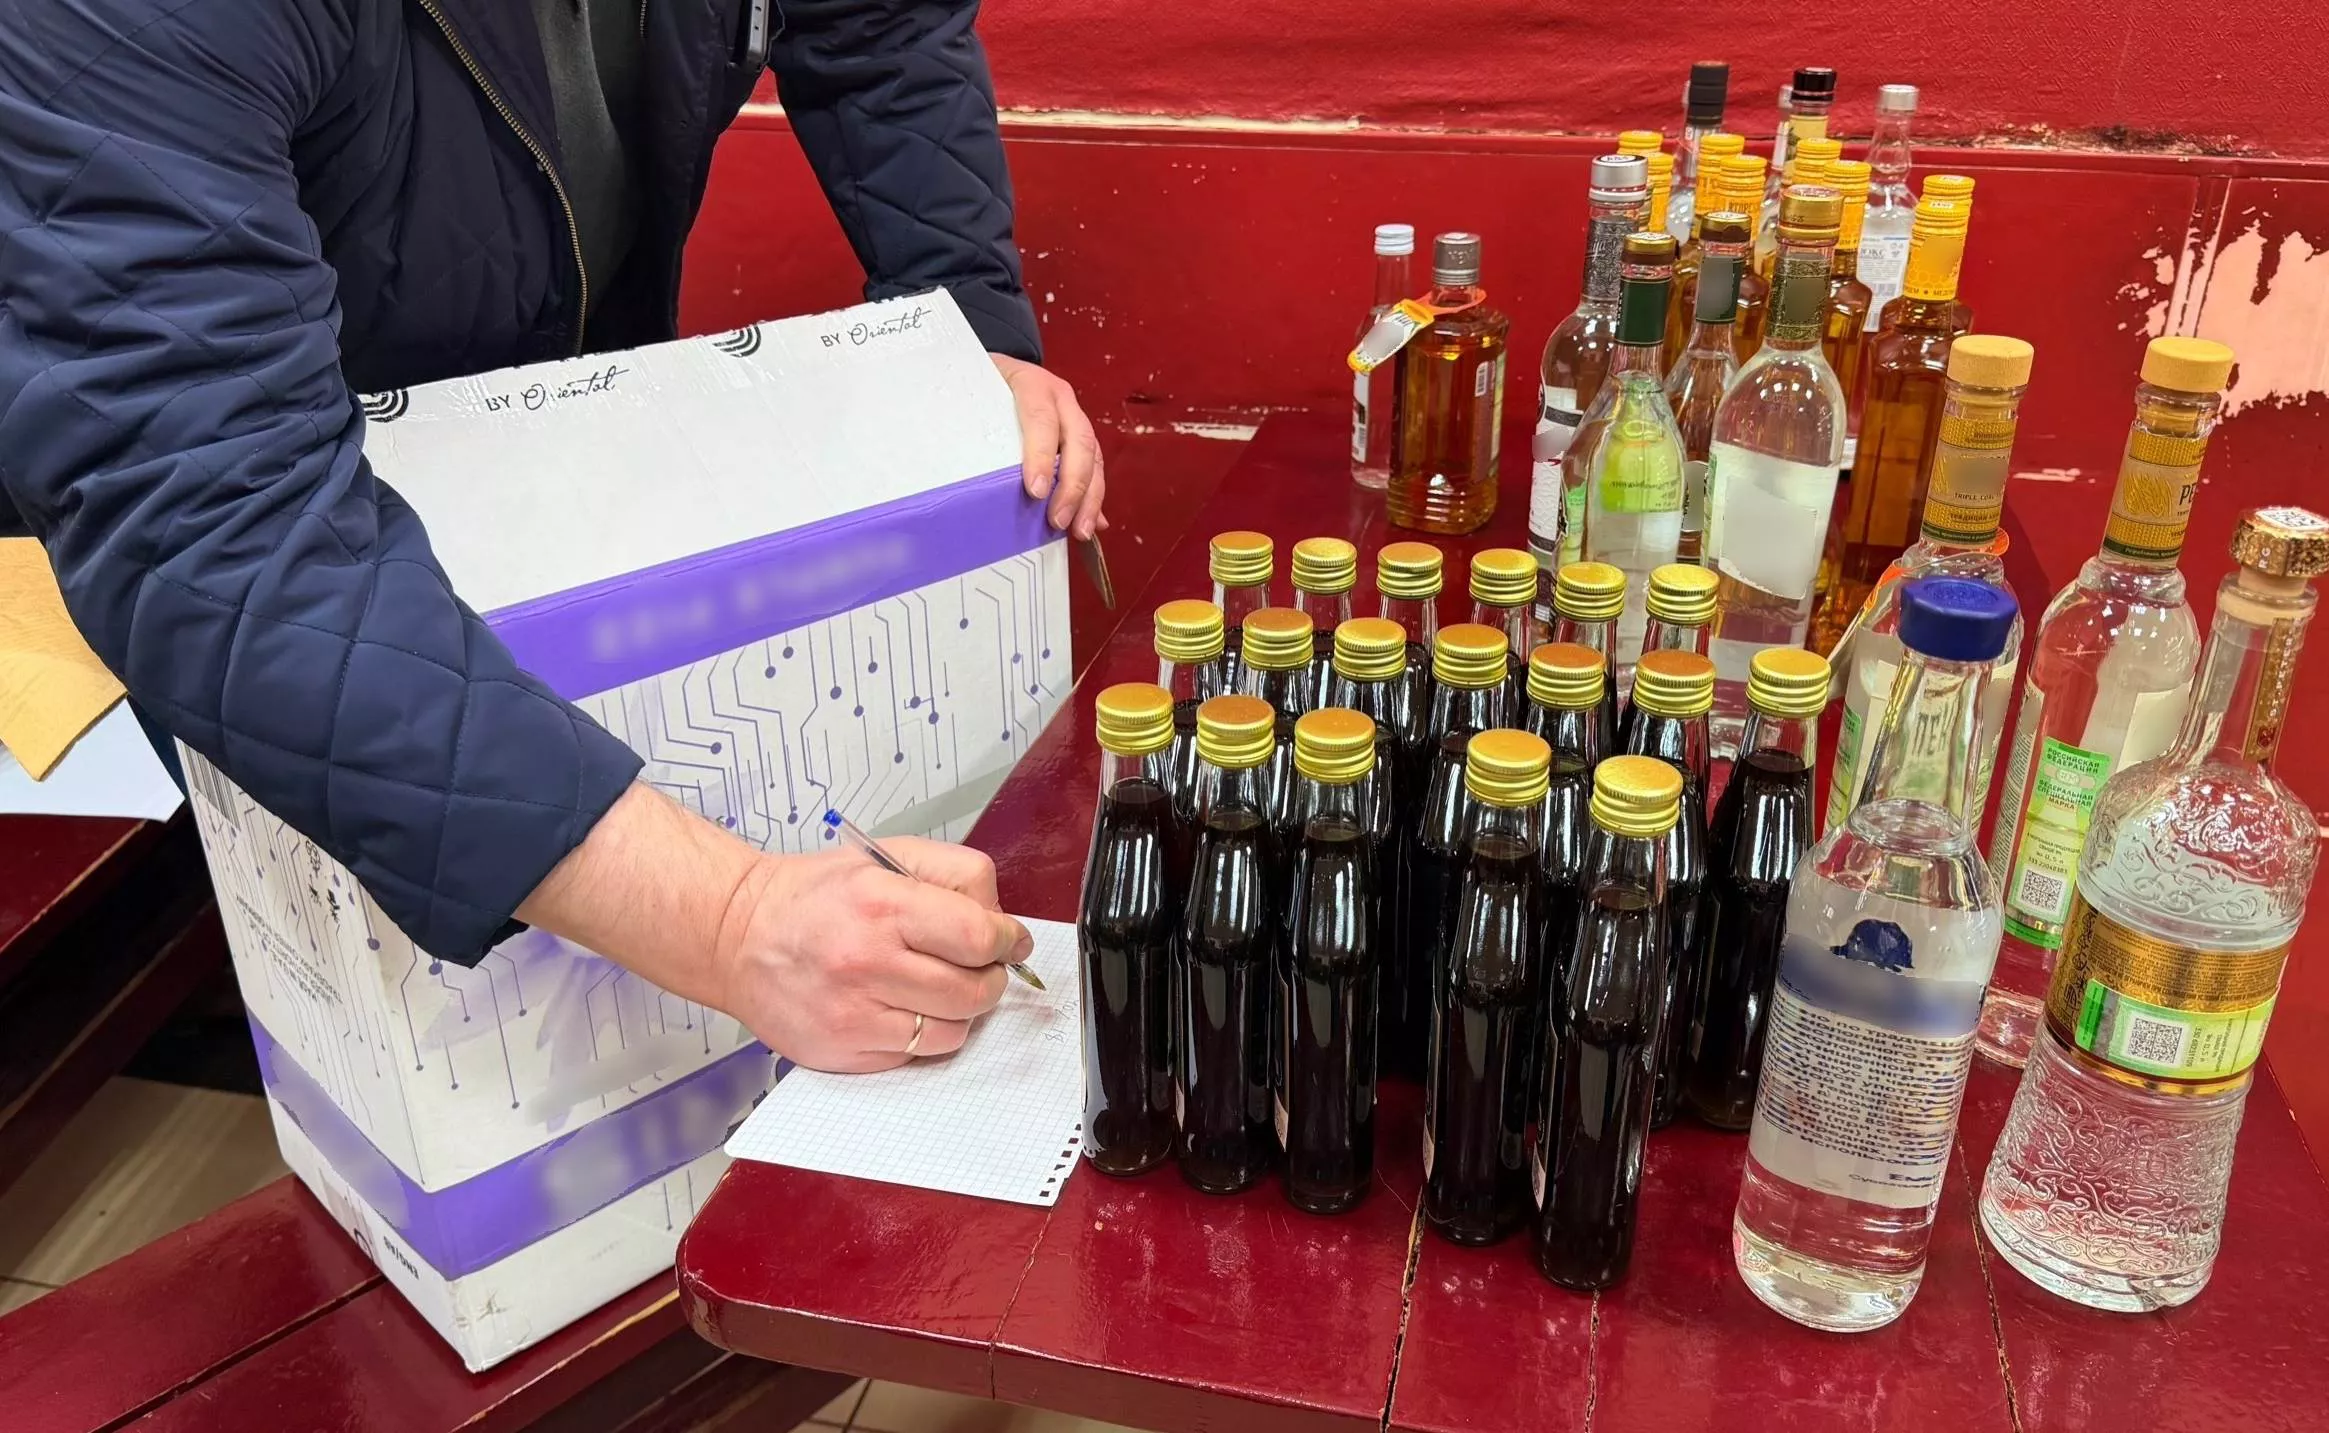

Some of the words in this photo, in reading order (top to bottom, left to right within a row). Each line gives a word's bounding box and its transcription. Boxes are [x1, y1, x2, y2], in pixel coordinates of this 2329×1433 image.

[820, 332, 841, 347] BY
[847, 306, 932, 345] Oriental
[485, 394, 510, 411] BY
[2046, 753, 2099, 774] ФЕДЕРАЦИЯ
[2047, 747, 2100, 768] РОССИЙСКАЯ
[2037, 785, 2092, 807] СПЕЦИАЛЬНАЯ
[2038, 779, 2094, 801] ФЕДЕРАЛЬНАЯ
[2048, 796, 2075, 810] МАРКА
[1836, 1021, 1860, 1032] по
[1892, 1041, 1917, 1051] из
[1818, 1060, 1862, 1078] вкус
[1868, 1074, 1880, 1082] и
[1797, 1097, 1859, 1120] более
[1826, 1113, 1870, 1131] (при
[1867, 1132, 1891, 1142] не
